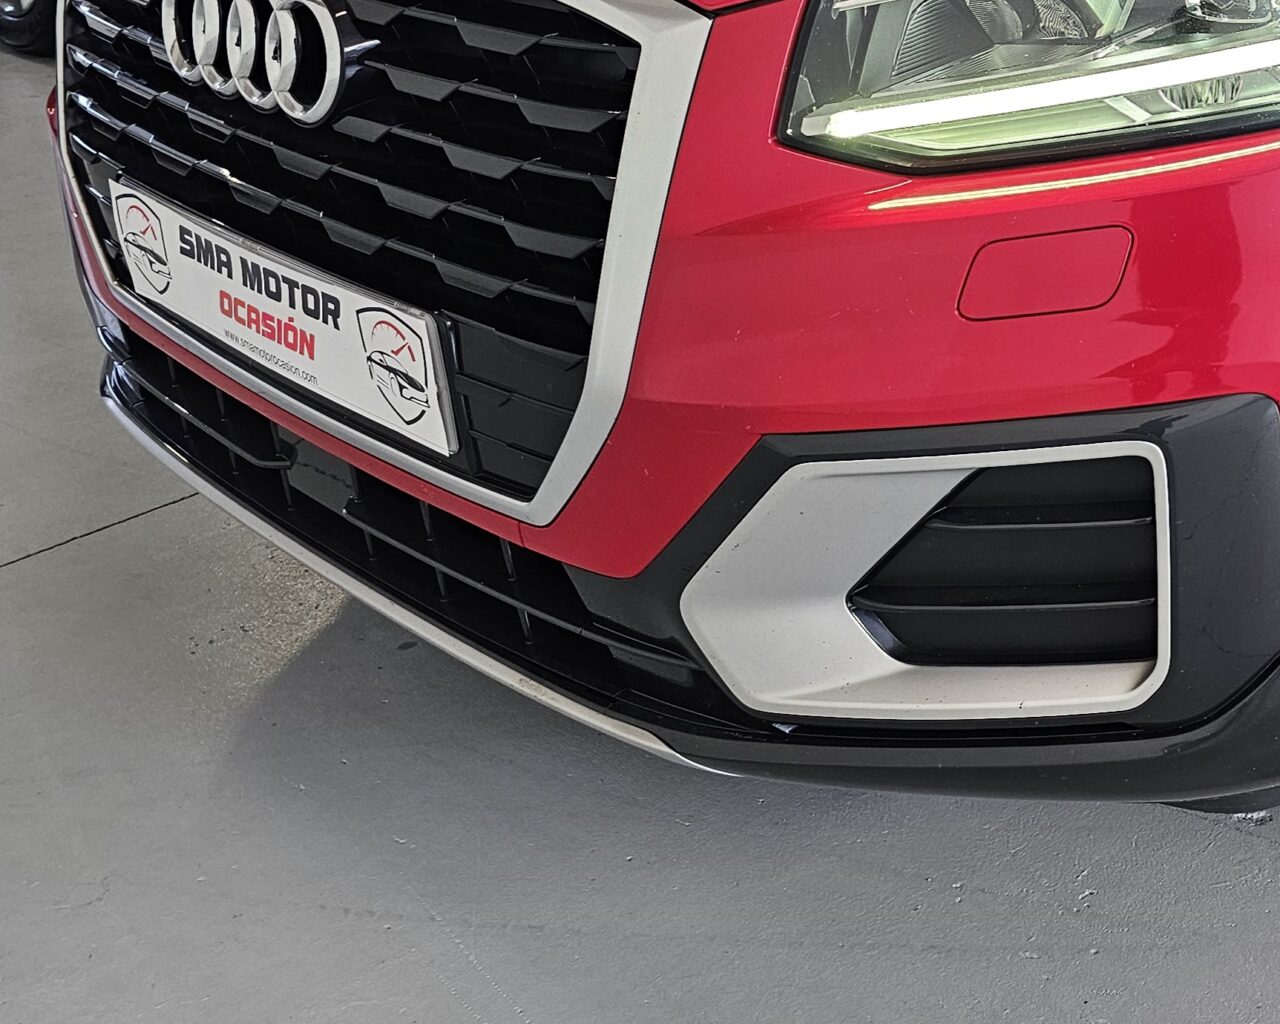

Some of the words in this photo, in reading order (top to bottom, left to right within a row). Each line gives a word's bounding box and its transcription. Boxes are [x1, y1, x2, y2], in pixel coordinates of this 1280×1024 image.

[178, 224, 233, 280] SMA
[240, 255, 341, 330] MOTOR
[219, 290, 316, 361] OCASIÓN
[223, 328, 318, 386] www.smamotorocasion.com
